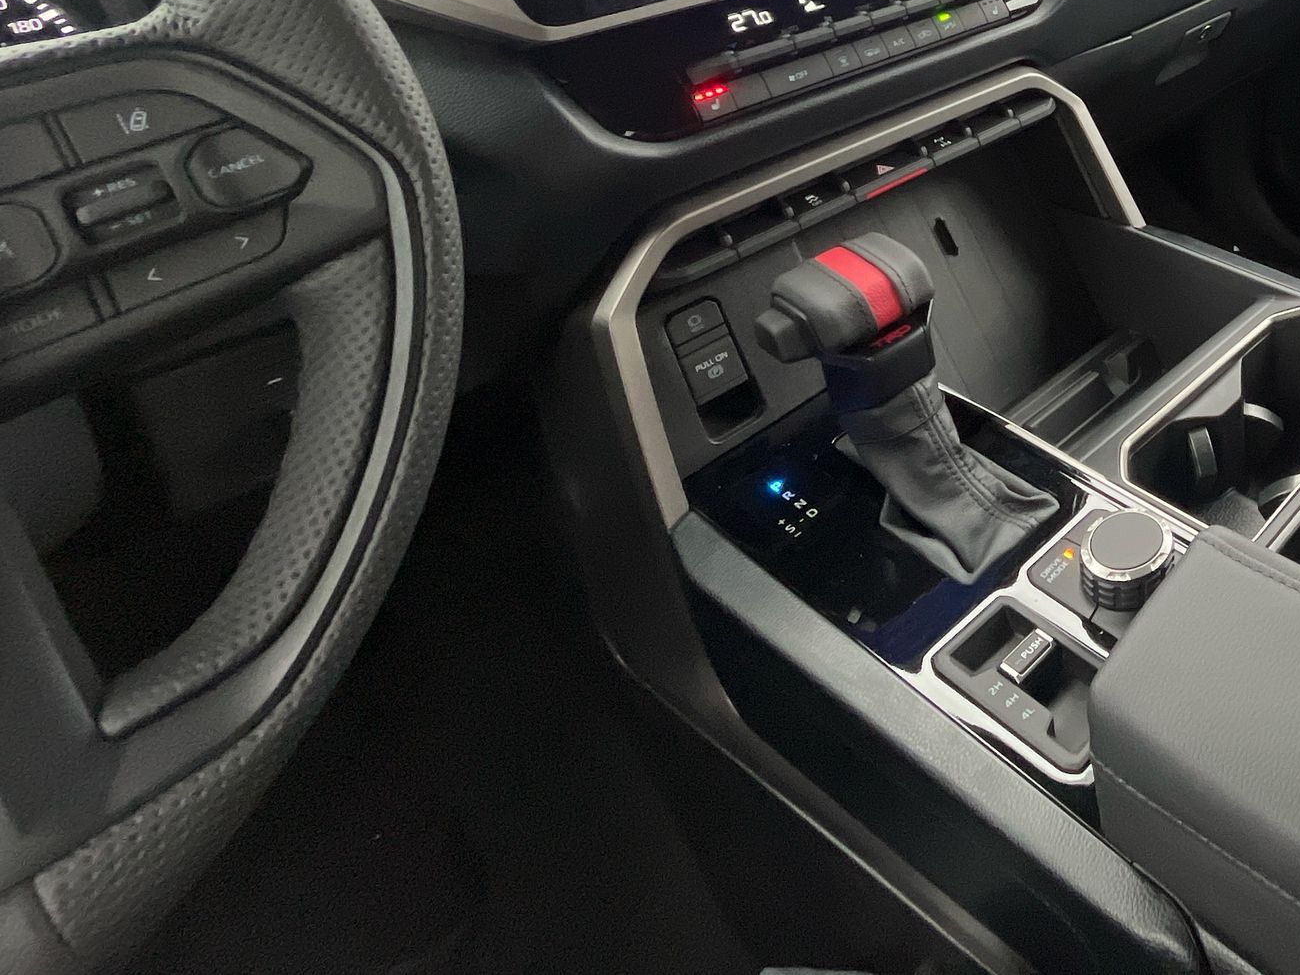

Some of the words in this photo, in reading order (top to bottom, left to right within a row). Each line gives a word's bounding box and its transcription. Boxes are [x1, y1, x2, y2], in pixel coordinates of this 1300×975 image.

[7, 18, 43, 34] 180
[208, 154, 265, 178] CANCEL
[695, 358, 714, 373] PULL
[714, 351, 729, 363] ON
[782, 491, 796, 501] R
[794, 498, 807, 510] N
[806, 508, 819, 518] D
[1040, 557, 1062, 579] DRIVE
[1046, 561, 1069, 584] MODE
[1020, 637, 1045, 660] PUSH
[988, 680, 1004, 697] 2H
[1004, 692, 1020, 709] 4H
[1021, 707, 1036, 721] 4L
